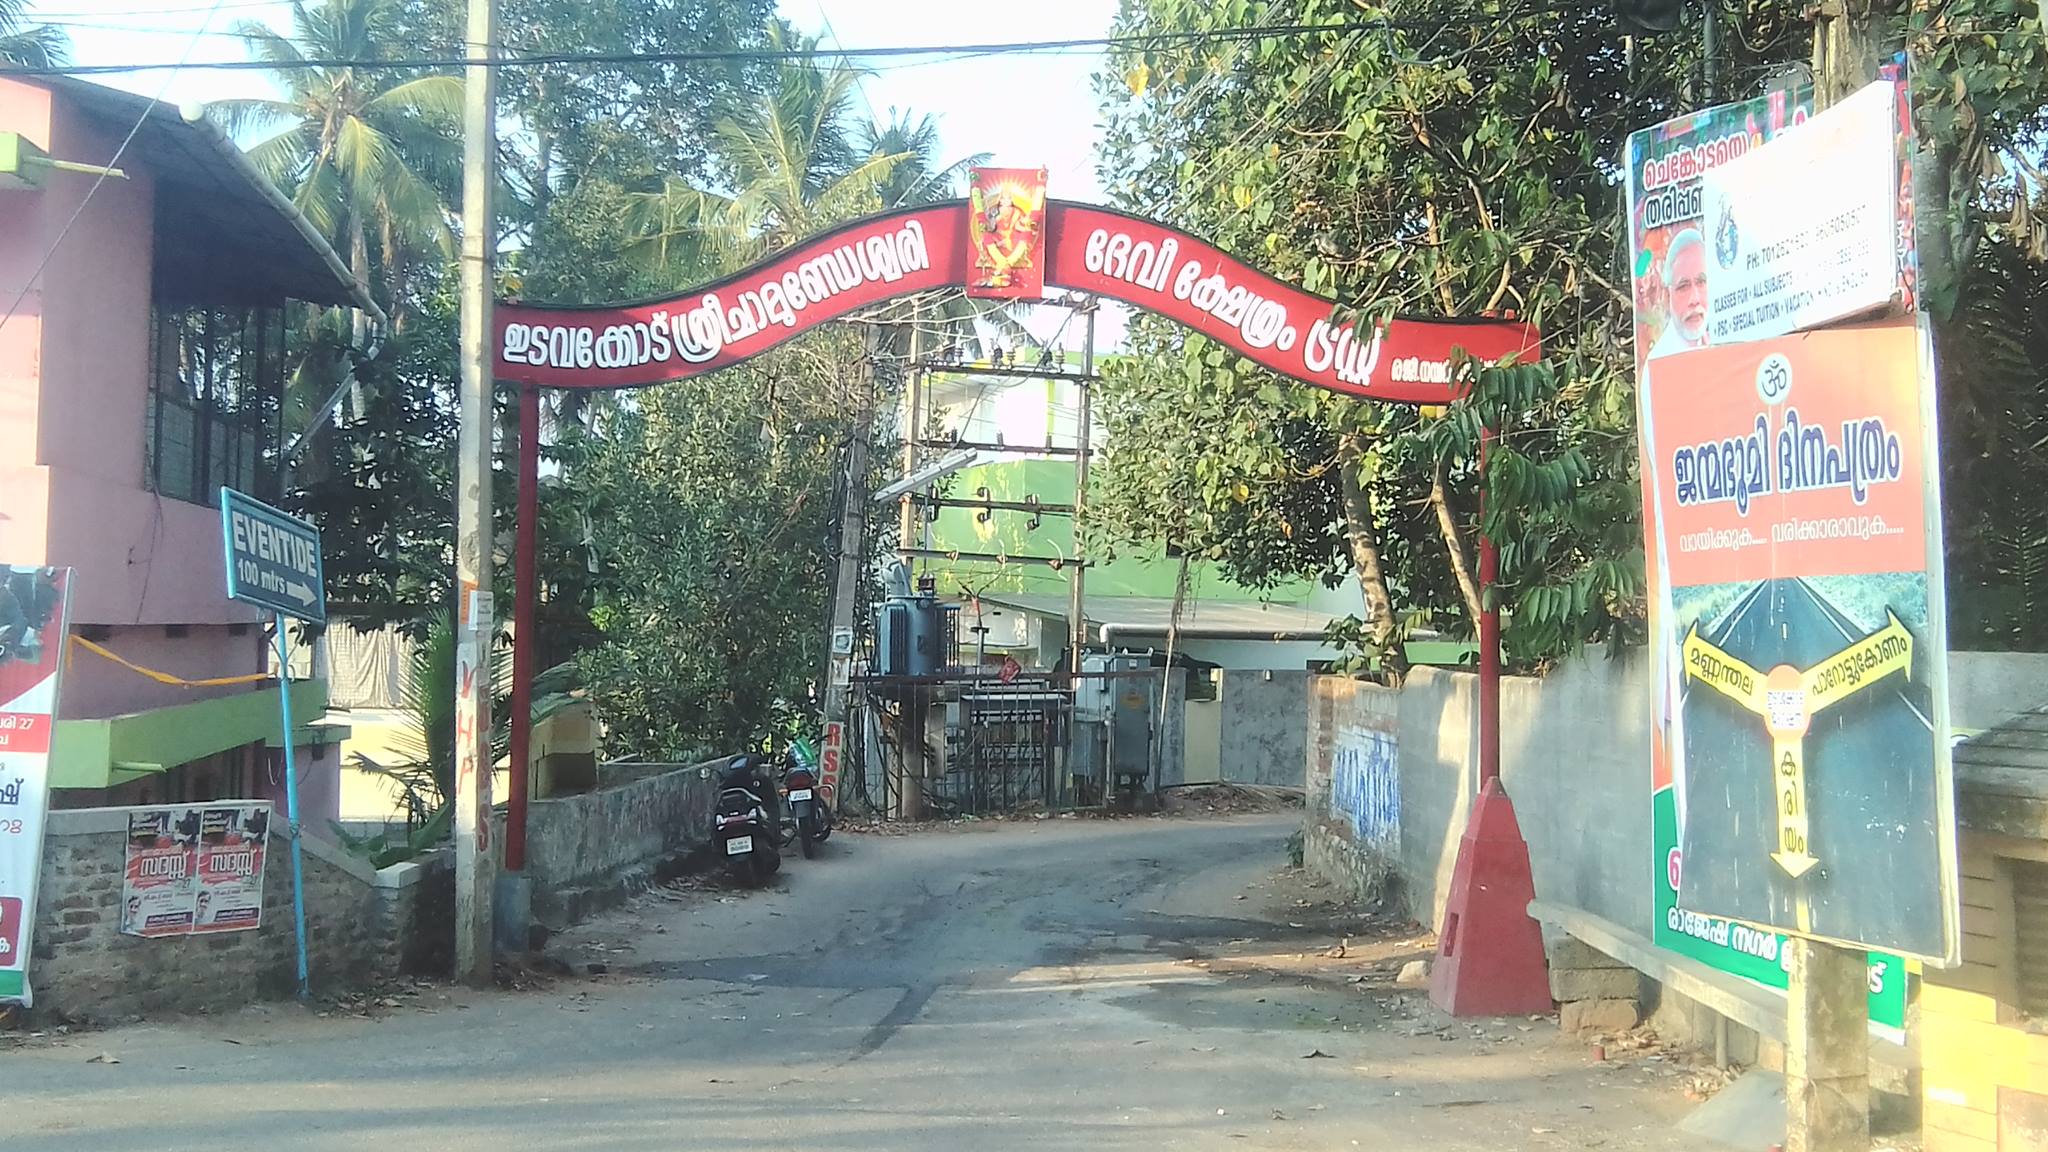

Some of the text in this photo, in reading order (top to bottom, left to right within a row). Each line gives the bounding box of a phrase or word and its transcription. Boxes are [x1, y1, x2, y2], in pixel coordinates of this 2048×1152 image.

[503, 311, 671, 368] ഇടവക്കോട്
[1173, 259, 1297, 351] ക്ഷേത്രം
[1778, 410, 1900, 502] ദിനപത്രം
[232, 511, 317, 578] EVENTIDE
[238, 558, 286, 594] 100 mtrs
[1690, 647, 1753, 696] മണ്ണന്തല
[19, 718, 34, 730] 27
[821, 723, 842, 799] RSS
